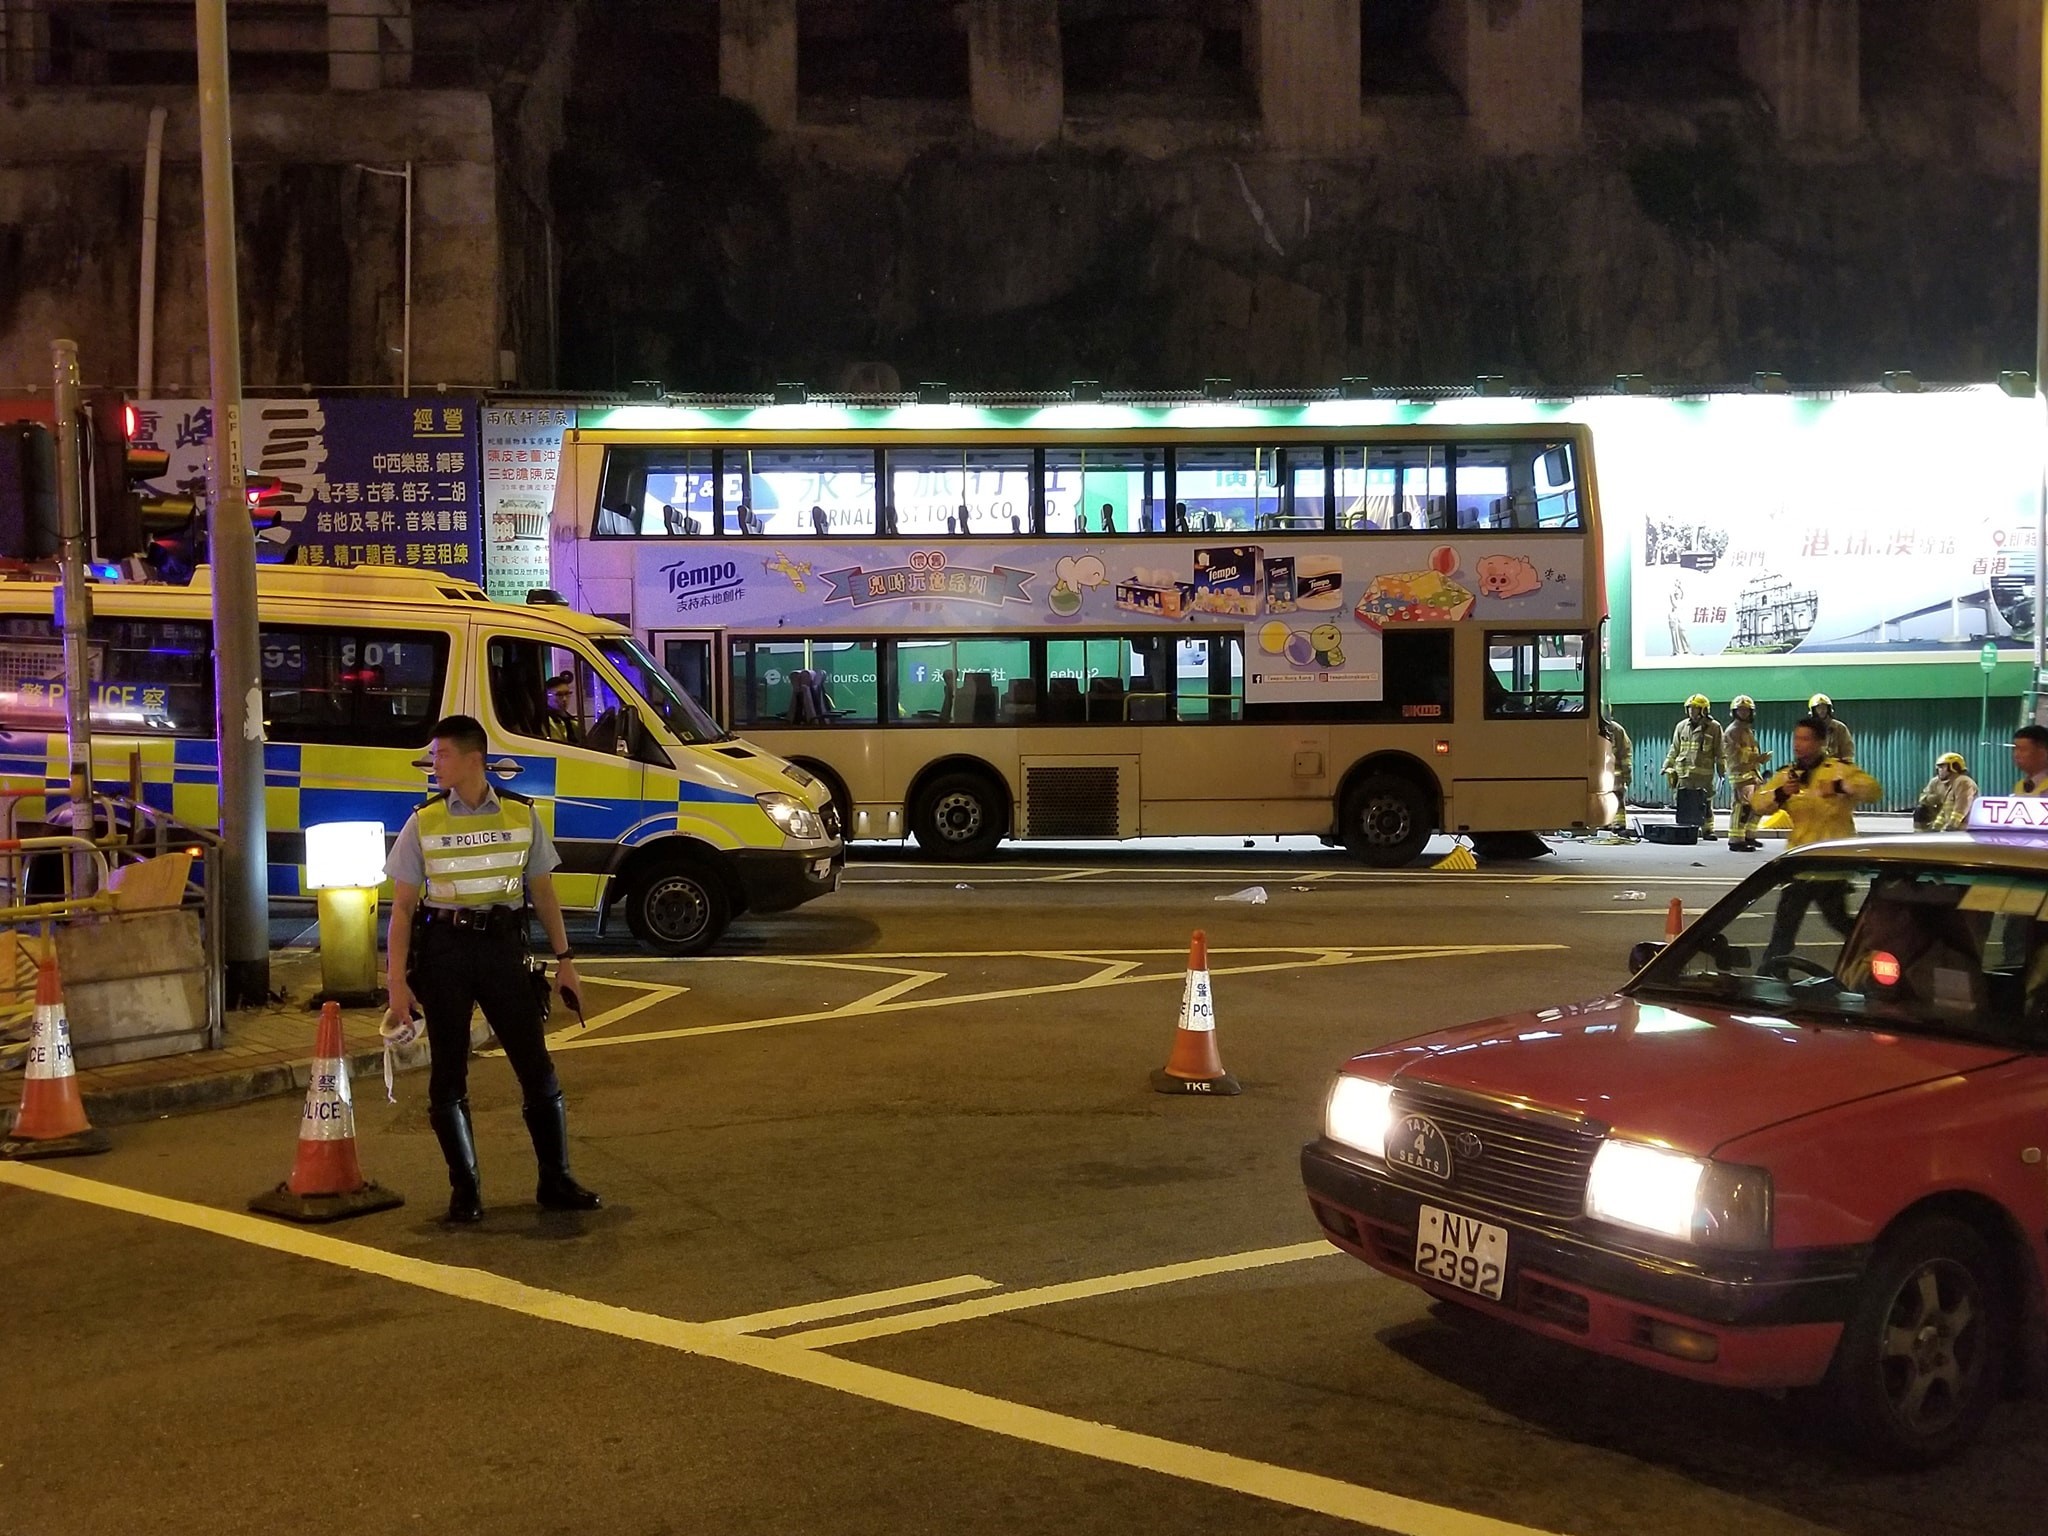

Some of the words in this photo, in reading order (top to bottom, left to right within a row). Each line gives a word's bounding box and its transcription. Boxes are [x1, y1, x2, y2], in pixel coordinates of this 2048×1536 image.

[413, 408, 463, 431] 經營
[659, 561, 737, 594] Tempo
[1206, 565, 1237, 581] Tempo
[1693, 606, 1728, 624] 珠海
[49, 683, 136, 710] PICE
[456, 832, 498, 846] POLICE
[1184, 1082, 1211, 1092] TKE
[1406, 1118, 1436, 1139] TAXI
[1414, 1133, 1426, 1155] 4
[1399, 1149, 1440, 1172] SEATS
[1441, 1213, 1482, 1252] NV
[1418, 1243, 1499, 1296] 2392
